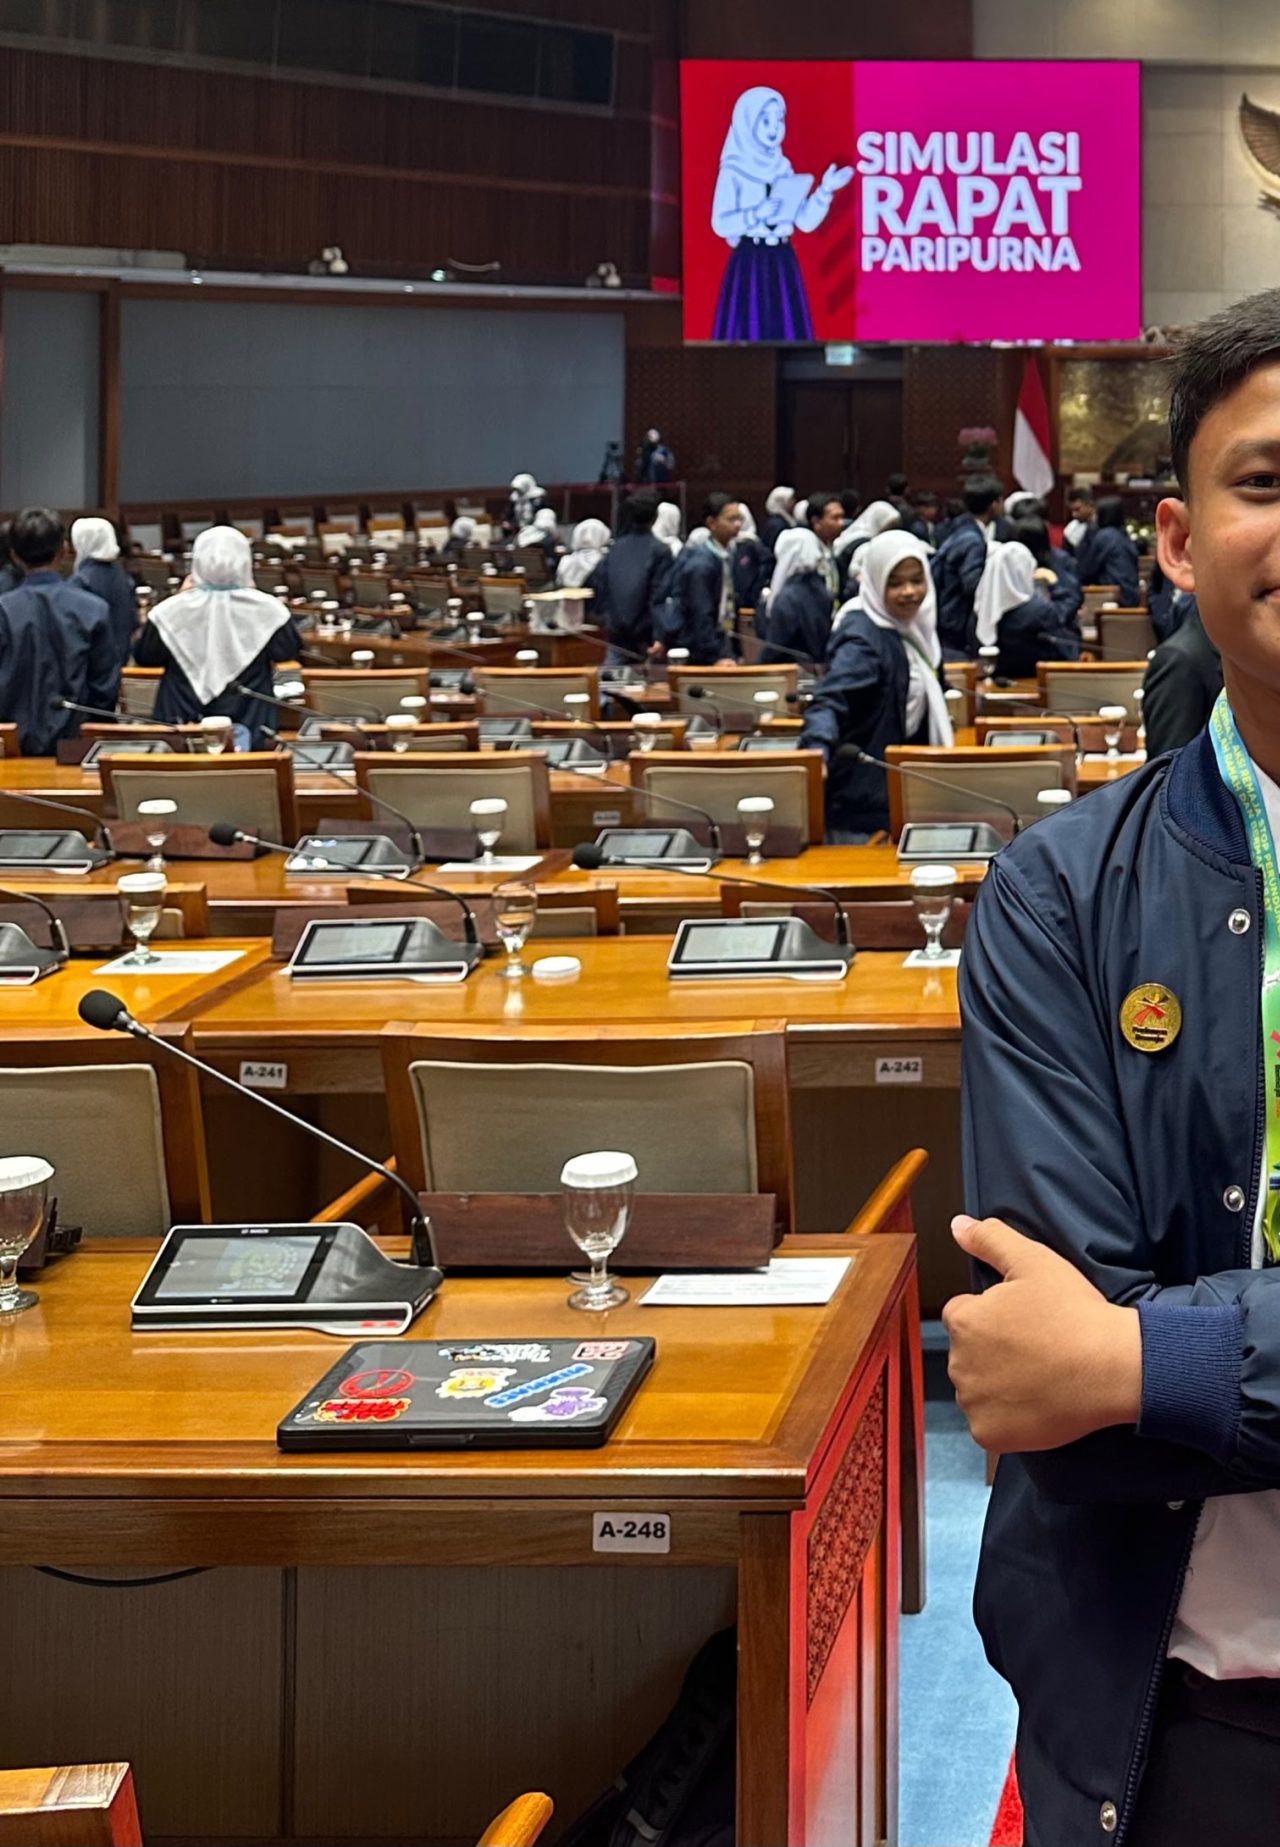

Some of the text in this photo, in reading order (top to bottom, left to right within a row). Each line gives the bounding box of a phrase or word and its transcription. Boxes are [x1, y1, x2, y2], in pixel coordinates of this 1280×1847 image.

[856, 131, 1080, 175] SIMULASI
[861, 175, 1082, 236] RAPAT
[861, 236, 1081, 273] PARIPURNA
[1239, 792, 1255, 819] DAN
[1241, 765, 1261, 819] REMAJA
[1257, 818, 1270, 852] STOP
[244, 1065, 283, 1078] A-241
[880, 1061, 919, 1072] A-242
[599, 1521, 667, 1539] A-248
